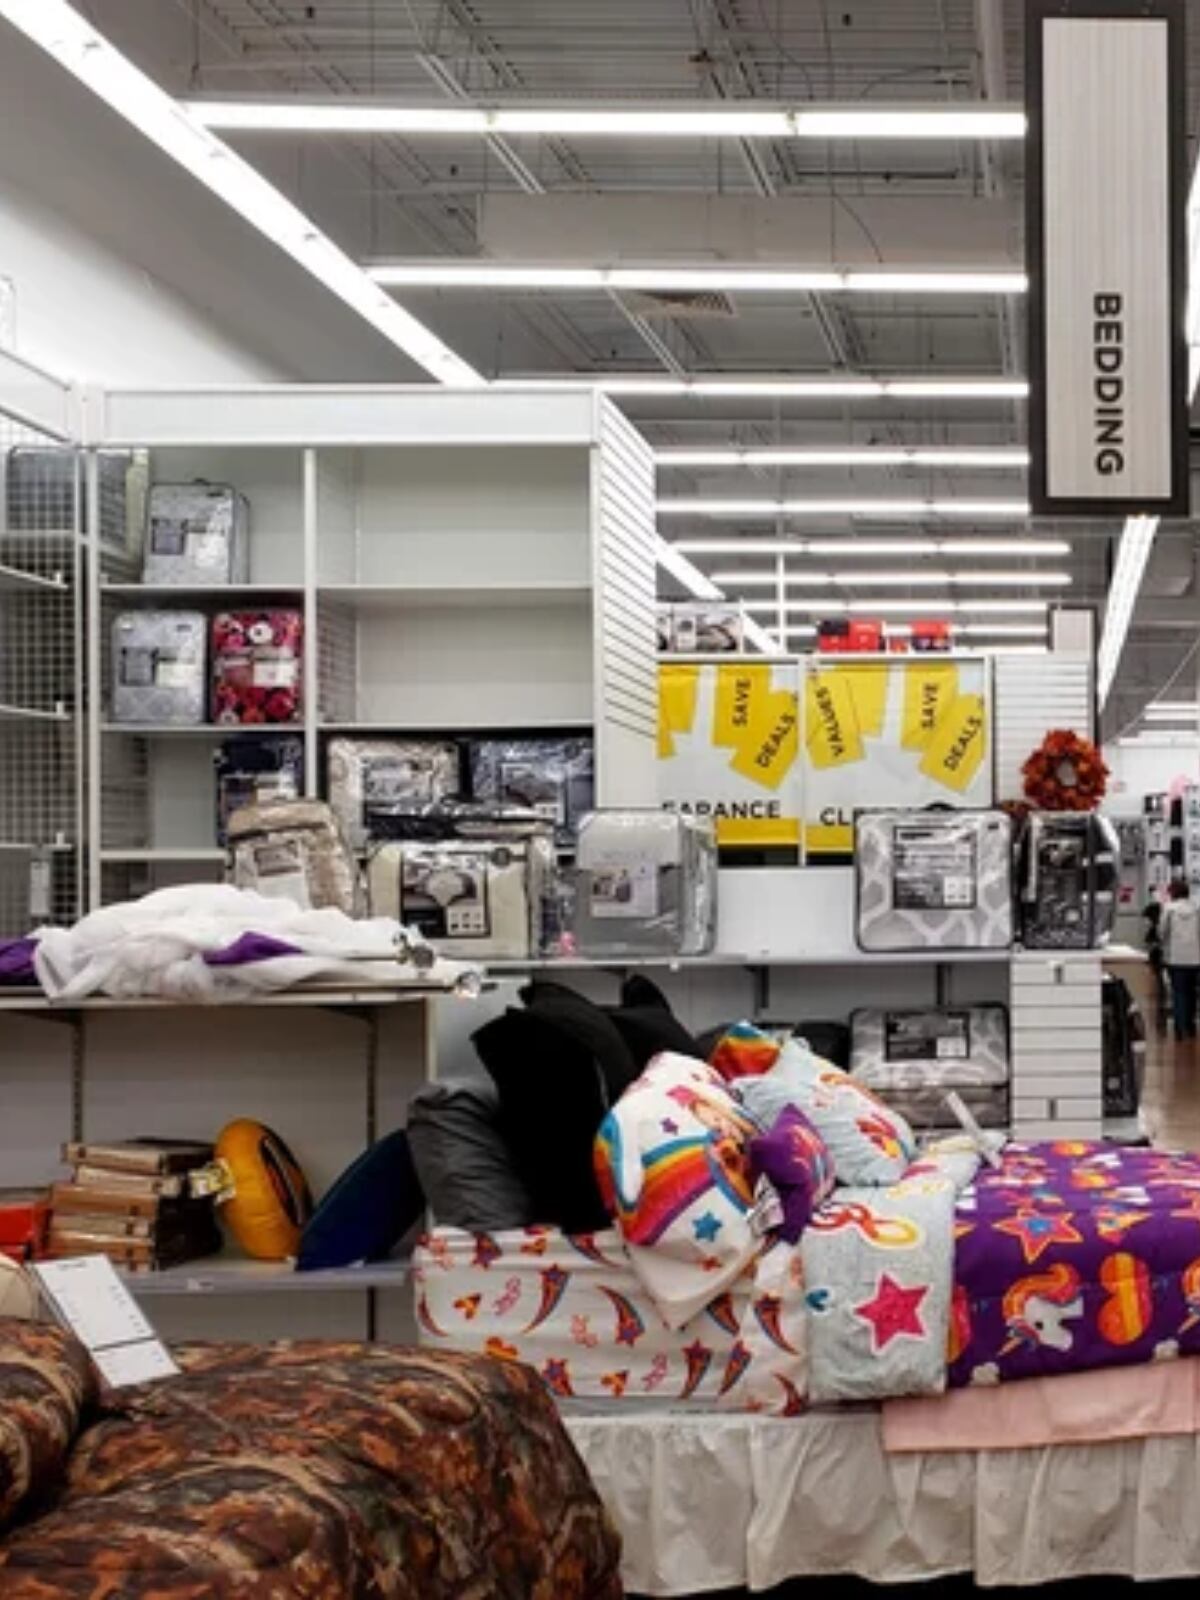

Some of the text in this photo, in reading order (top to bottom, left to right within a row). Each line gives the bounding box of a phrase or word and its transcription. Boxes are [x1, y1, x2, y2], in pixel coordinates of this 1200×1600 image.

[1094, 292, 1124, 476] BEDDING
[732, 678, 752, 728] SAVE
[816, 686, 844, 758] VALUES
[921, 682, 940, 730] SAVE
[755, 712, 796, 768] DEALS
[943, 715, 983, 771] DEALS
